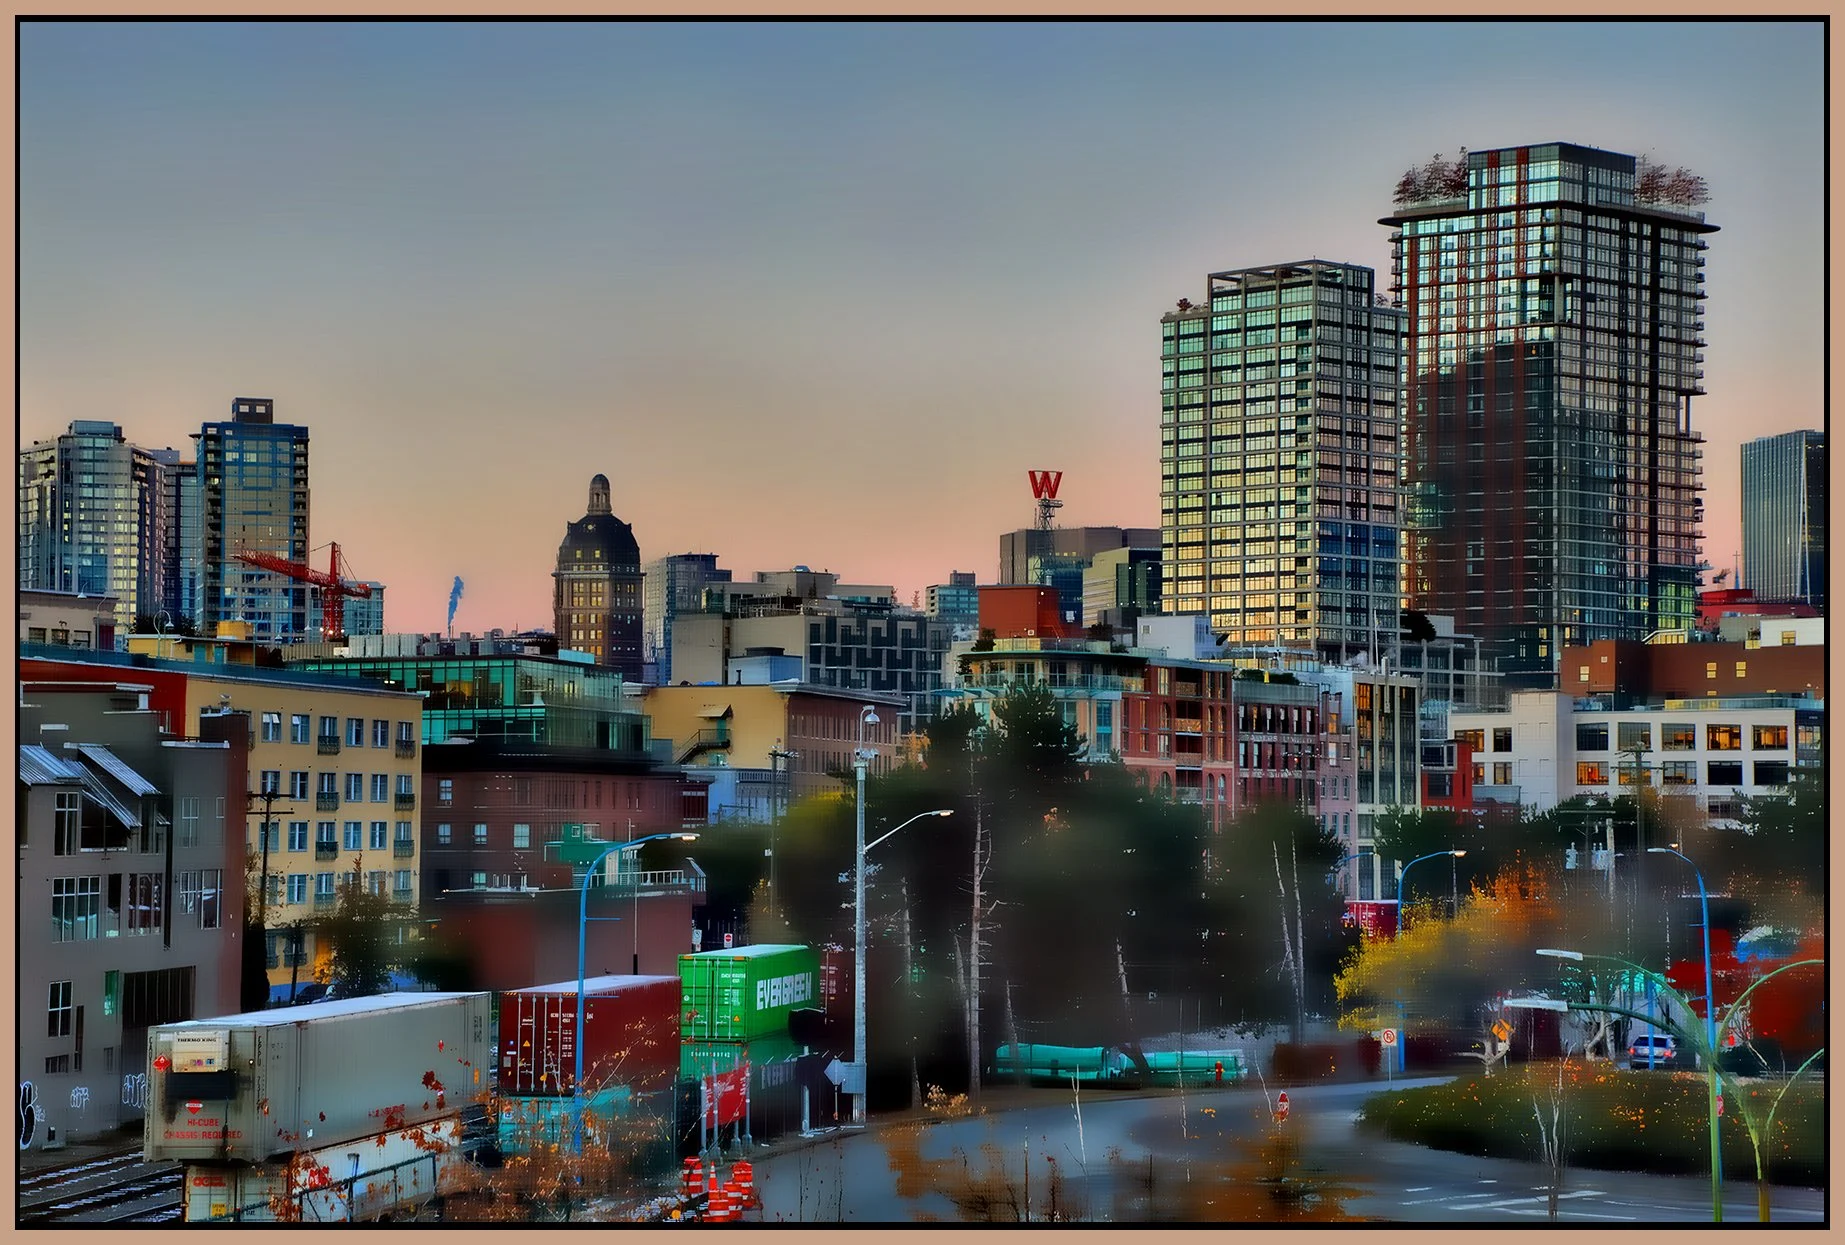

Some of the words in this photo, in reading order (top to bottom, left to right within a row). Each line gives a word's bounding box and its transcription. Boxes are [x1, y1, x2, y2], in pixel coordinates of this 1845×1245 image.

[1028, 470, 1062, 499] W
[757, 972, 811, 1010] EVERGREEN
[187, 1118, 219, 1126] HI-CUBE
[163, 1131, 198, 1139] CHASSIS
[202, 1131, 242, 1139] REQURED
